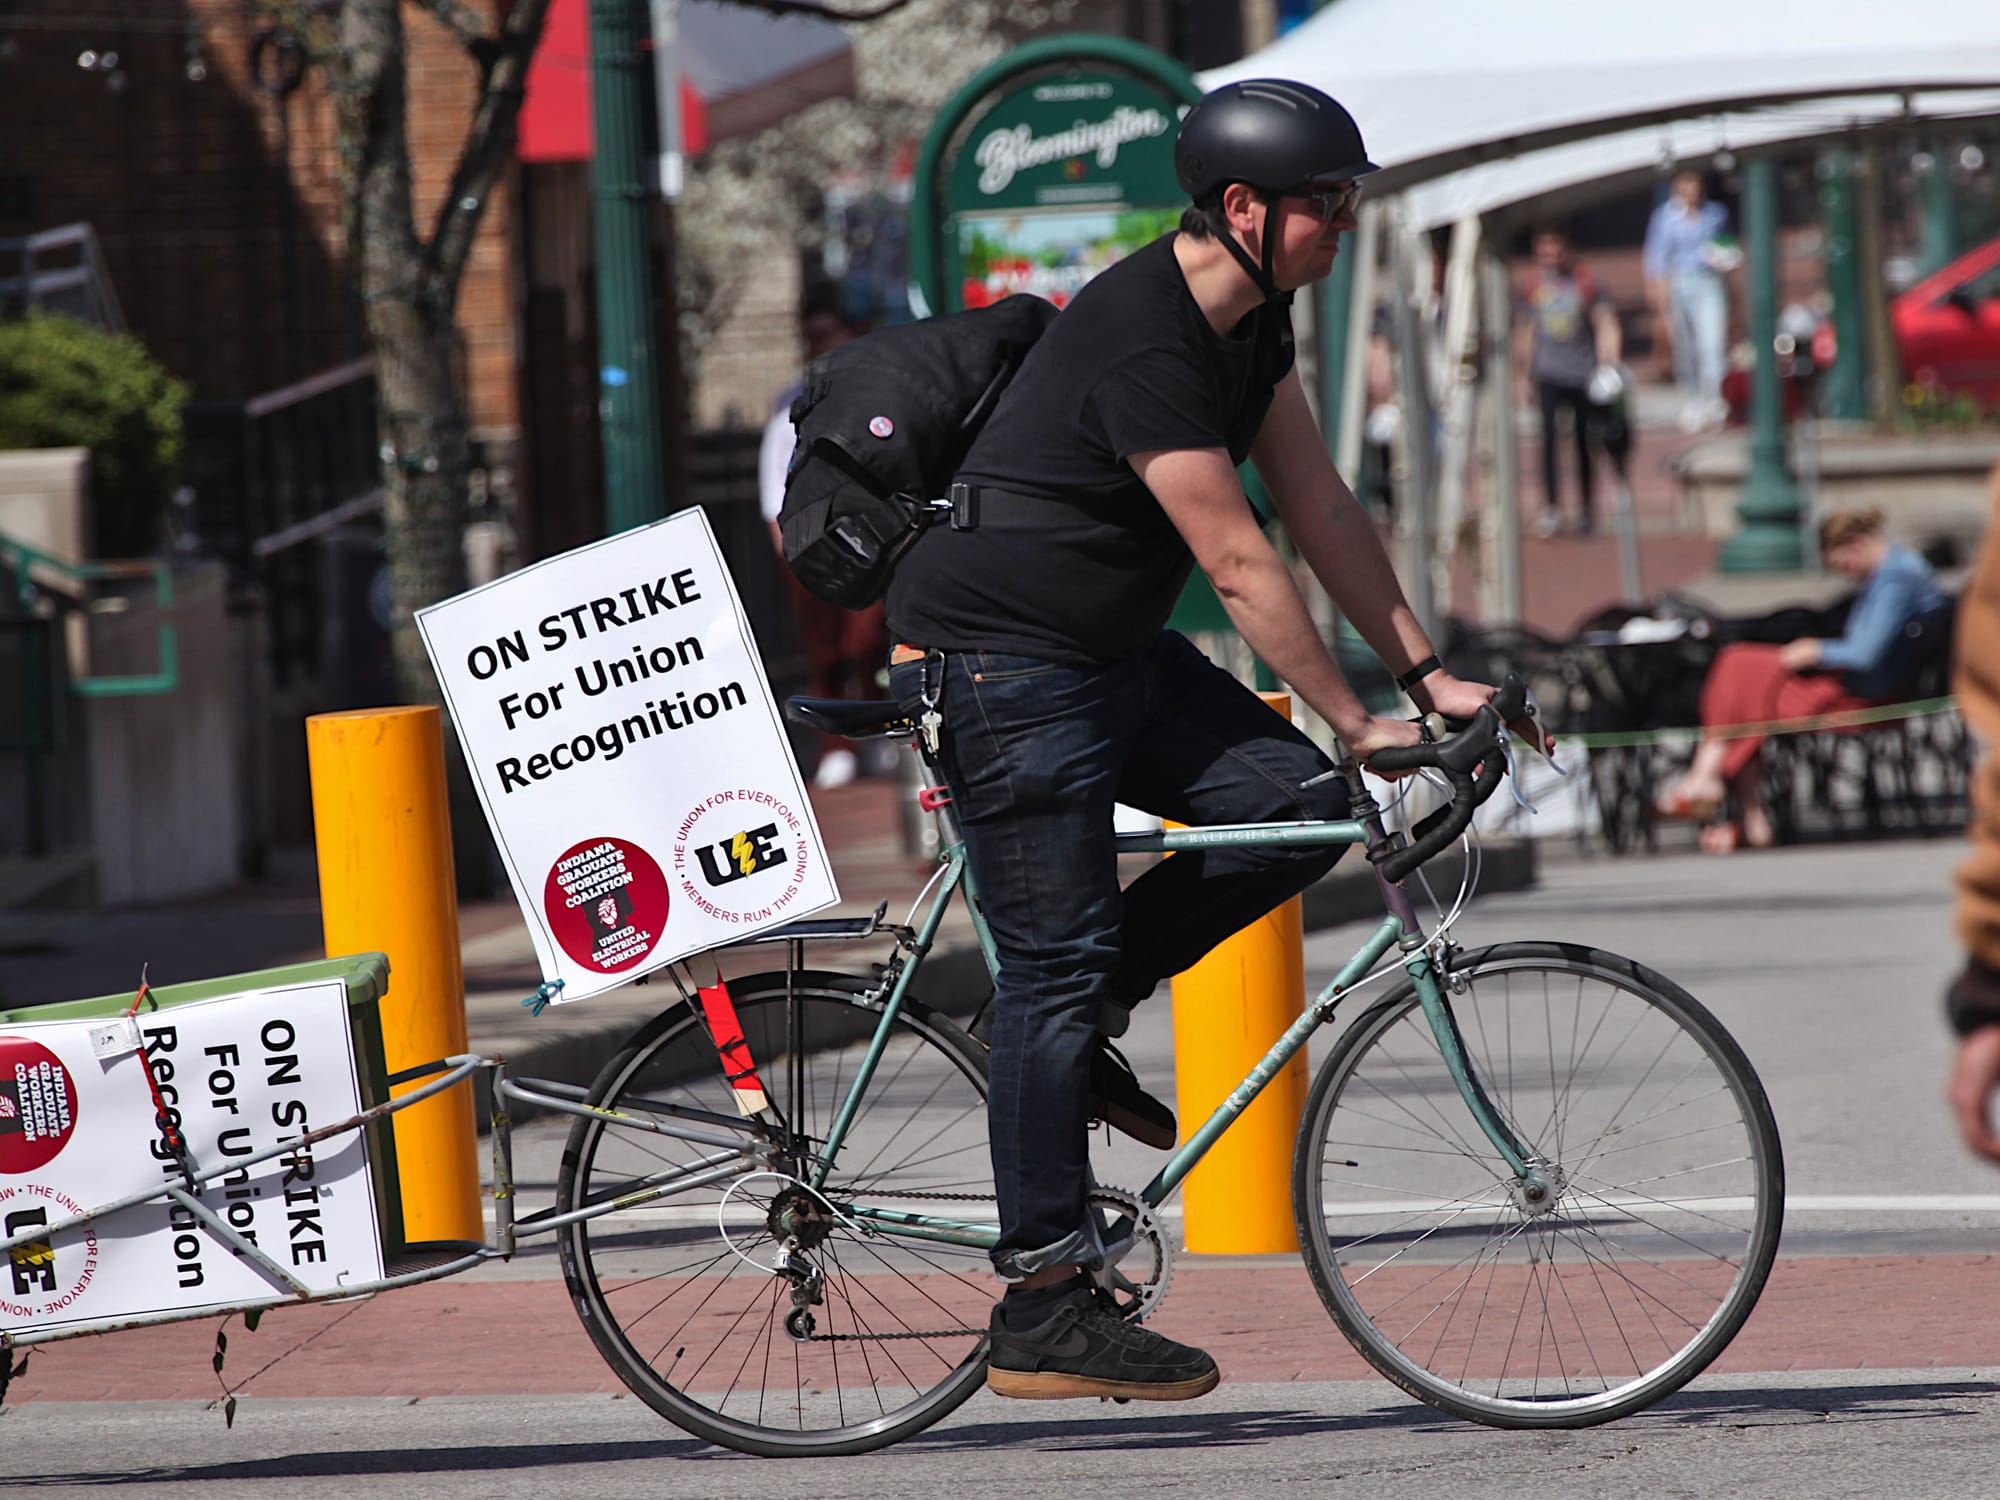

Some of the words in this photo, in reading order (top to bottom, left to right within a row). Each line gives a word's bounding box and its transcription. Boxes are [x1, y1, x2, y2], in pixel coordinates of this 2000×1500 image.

[976, 105, 1169, 194] Bloomington
[467, 630, 530, 680] ON
[538, 568, 702, 652] STRIKE
[498, 682, 565, 731] For
[575, 635, 704, 697] Union
[495, 680, 747, 794] Recognition
[706, 790, 735, 808] FOR
[738, 789, 801, 831] EVERYONE
[677, 804, 707, 841] UNION
[557, 841, 616, 873] INDIANA
[557, 850, 625, 886] GRADUATE
[674, 844, 686, 871] THE
[694, 822, 788, 887] UE
[563, 862, 627, 895] WORKERS
[565, 871, 634, 909] COALITION
[681, 880, 740, 923] MEMBERS
[743, 907, 773, 923] RUN
[772, 885, 798, 911] THIS
[793, 840, 808, 883] UNION
[591, 930, 651, 963] ELECTRICAL
[598, 925, 635, 948] UNITED
[600, 942, 648, 969] WORKERS
[260, 1019, 302, 1086] ON
[39, 1061, 60, 1138] GRADUATE
[52, 1065, 71, 1131] INDIANA
[204, 1043, 240, 1115] For
[15, 1062, 36, 1142] COALITION
[28, 1065, 48, 1137] WORKERS
[26, 1184, 54, 1199] THE
[272, 1100, 326, 1266] STRIKE
[55, 1192, 90, 1228] UNIO
[84, 1229, 98, 1256] FOR
[44, 1259, 97, 1314] EVERYONE
[0, 1300, 33, 1317] NION
